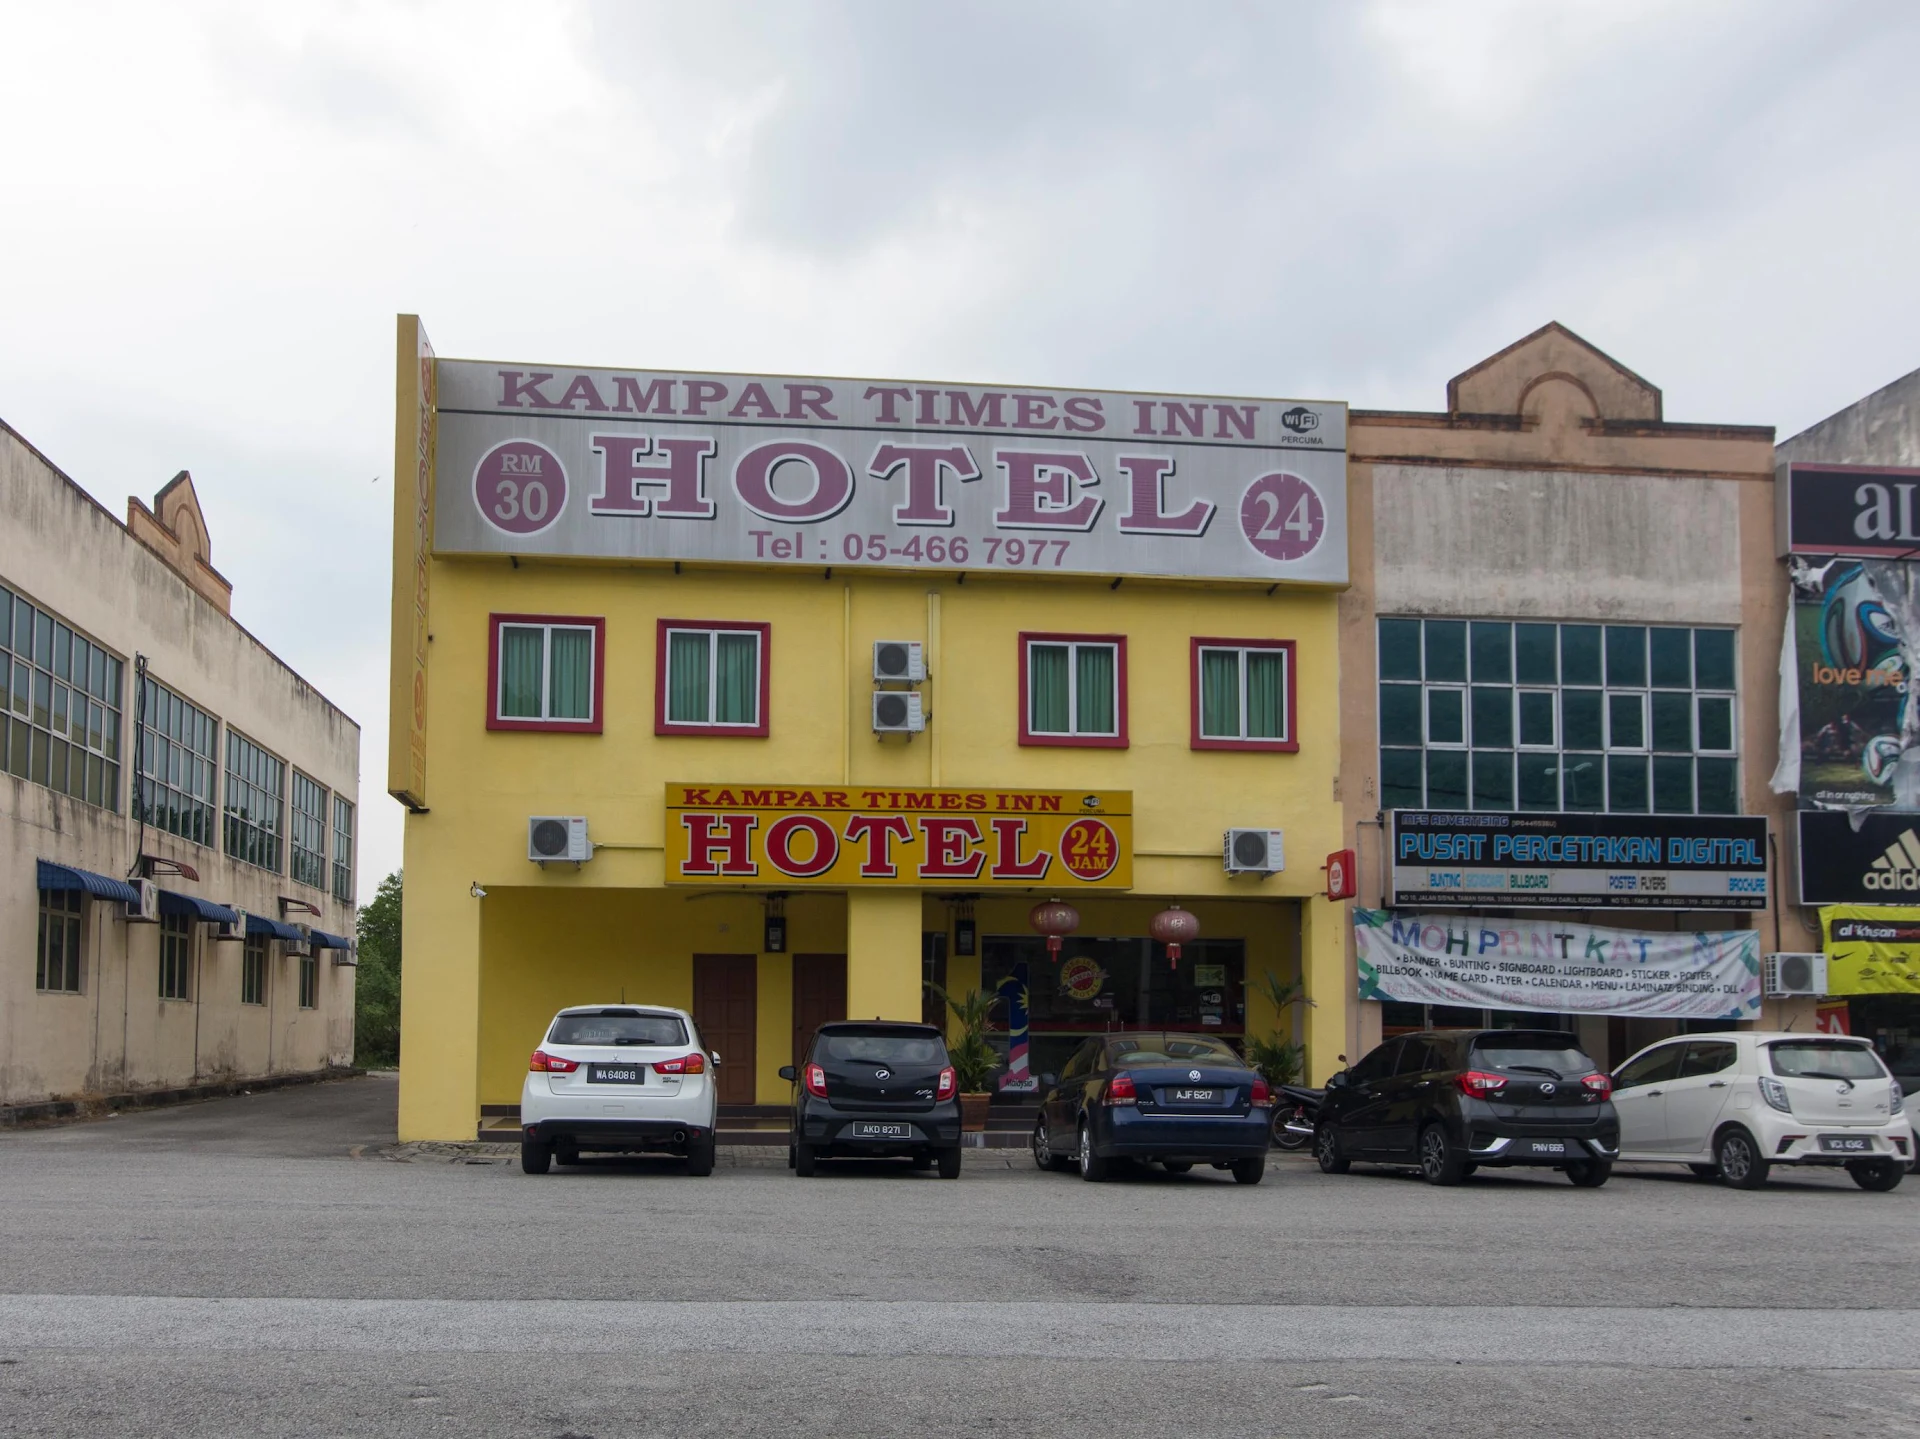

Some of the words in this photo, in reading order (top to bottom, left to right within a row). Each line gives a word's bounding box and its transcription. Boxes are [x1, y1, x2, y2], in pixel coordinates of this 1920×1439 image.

[497, 371, 839, 421] KAMPAR
[862, 386, 1107, 432] TIMES
[1132, 400, 1261, 440] INN
[1281, 436, 1324, 445] PERCUMA
[501, 453, 543, 474] RM
[588, 432, 1217, 537] HOTEL
[495, 480, 548, 522] 30
[1254, 491, 1313, 542] 24
[748, 531, 803, 559] Tel
[843, 533, 969, 563] 05-466
[982, 537, 1071, 567] 7977
[1813, 662, 1862, 685] love
[1866, 667, 1904, 687] me
[683, 788, 849, 808] KAMPAR
[861, 792, 988, 811] TIMES
[996, 794, 1063, 812] INN
[1816, 790, 1827, 799] all
[1827, 790, 1835, 799] in
[1835, 791, 1844, 799] or
[1844, 791, 1876, 801] nothing
[1402, 814, 1430, 826] MFS
[1431, 815, 1510, 827] ADVERTISING
[680, 812, 1052, 879] HOTEL
[1070, 826, 1110, 855] 24
[1400, 832, 1487, 861] PUSAT
[1493, 834, 1662, 864] PERCETAKAN
[1668, 837, 1763, 866] DIGITAL
[1069, 856, 1109, 869] JAM
[1430, 873, 1462, 888] BUNTING
[1510, 874, 1549, 889] BILLBOARD
[1609, 875, 1637, 890] POSTER
[1640, 875, 1667, 891] FLYERS
[1728, 877, 1766, 892] BROCHURE
[1863, 867, 1920, 891] adid
[1392, 919, 1469, 956] MOH
[1478, 926, 1575, 959] PRINT
[1584, 934, 1653, 964] KAT
[1376, 964, 1423, 979] BILLBOOK
[1430, 970, 1459, 982] NAME
[1461, 973, 1488, 984] CARD
[1495, 974, 1523, 986] FLYER
[1531, 977, 1582, 990] CALENDAR
[1591, 980, 1618, 992] MENU
[1723, 983, 1740, 994] DLL
[1402, 953, 1441, 968] BANNER
[1449, 959, 1491, 971] BUNTING
[1498, 963, 1556, 976] SIGNBOARD
[1563, 966, 1623, 979] LIGHTBOARD
[1631, 969, 1670, 981] STICKER
[1679, 971, 1714, 981] POSTER
[596, 1069, 607, 1079] WA
[608, 1070, 630, 1080] 6408
[629, 1071, 636, 1080] G
[1005, 1078, 1033, 1089] Malaysia
[1176, 1090, 1192, 1100] AJF
[1193, 1090, 1213, 1100] 6217
[863, 1125, 880, 1134] AKD
[882, 1126, 901, 1134] 8271
